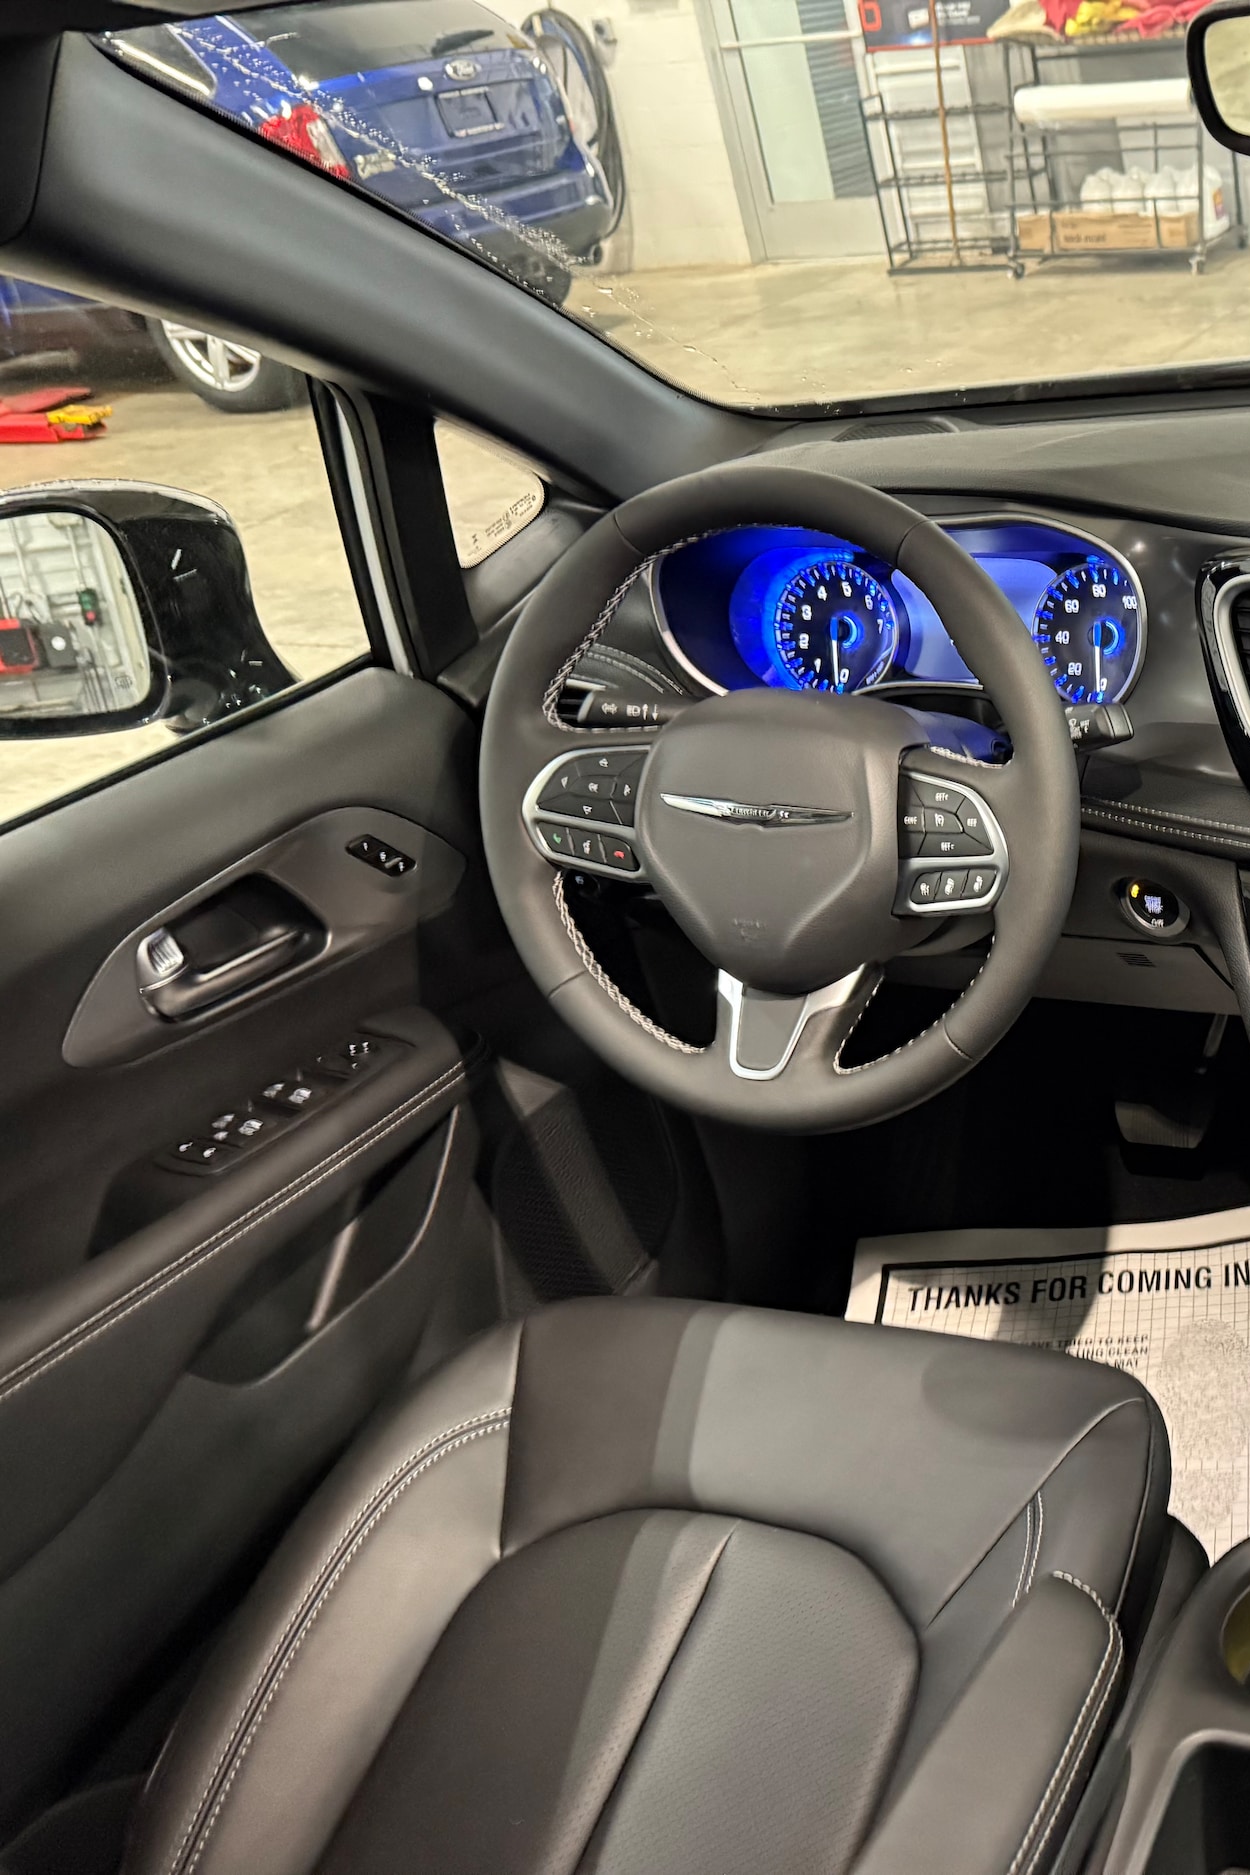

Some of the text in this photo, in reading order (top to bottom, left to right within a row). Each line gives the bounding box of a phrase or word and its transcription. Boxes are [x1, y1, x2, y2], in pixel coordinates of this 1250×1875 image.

[817, 585, 827, 601] 4
[1122, 595, 1137, 610] 100
[876, 618, 884, 634] 7
[1055, 630, 1069, 645] 40
[814, 658, 822, 673] 1
[839, 668, 849, 684] 0
[908, 1260, 1250, 1312] THANKS FOR COMING IN
[1099, 1336, 1113, 1345] TO
[1117, 1333, 1148, 1344] KEEP
[1109, 1346, 1148, 1357] CLEAN
[1114, 1358, 1138, 1369] MAT
